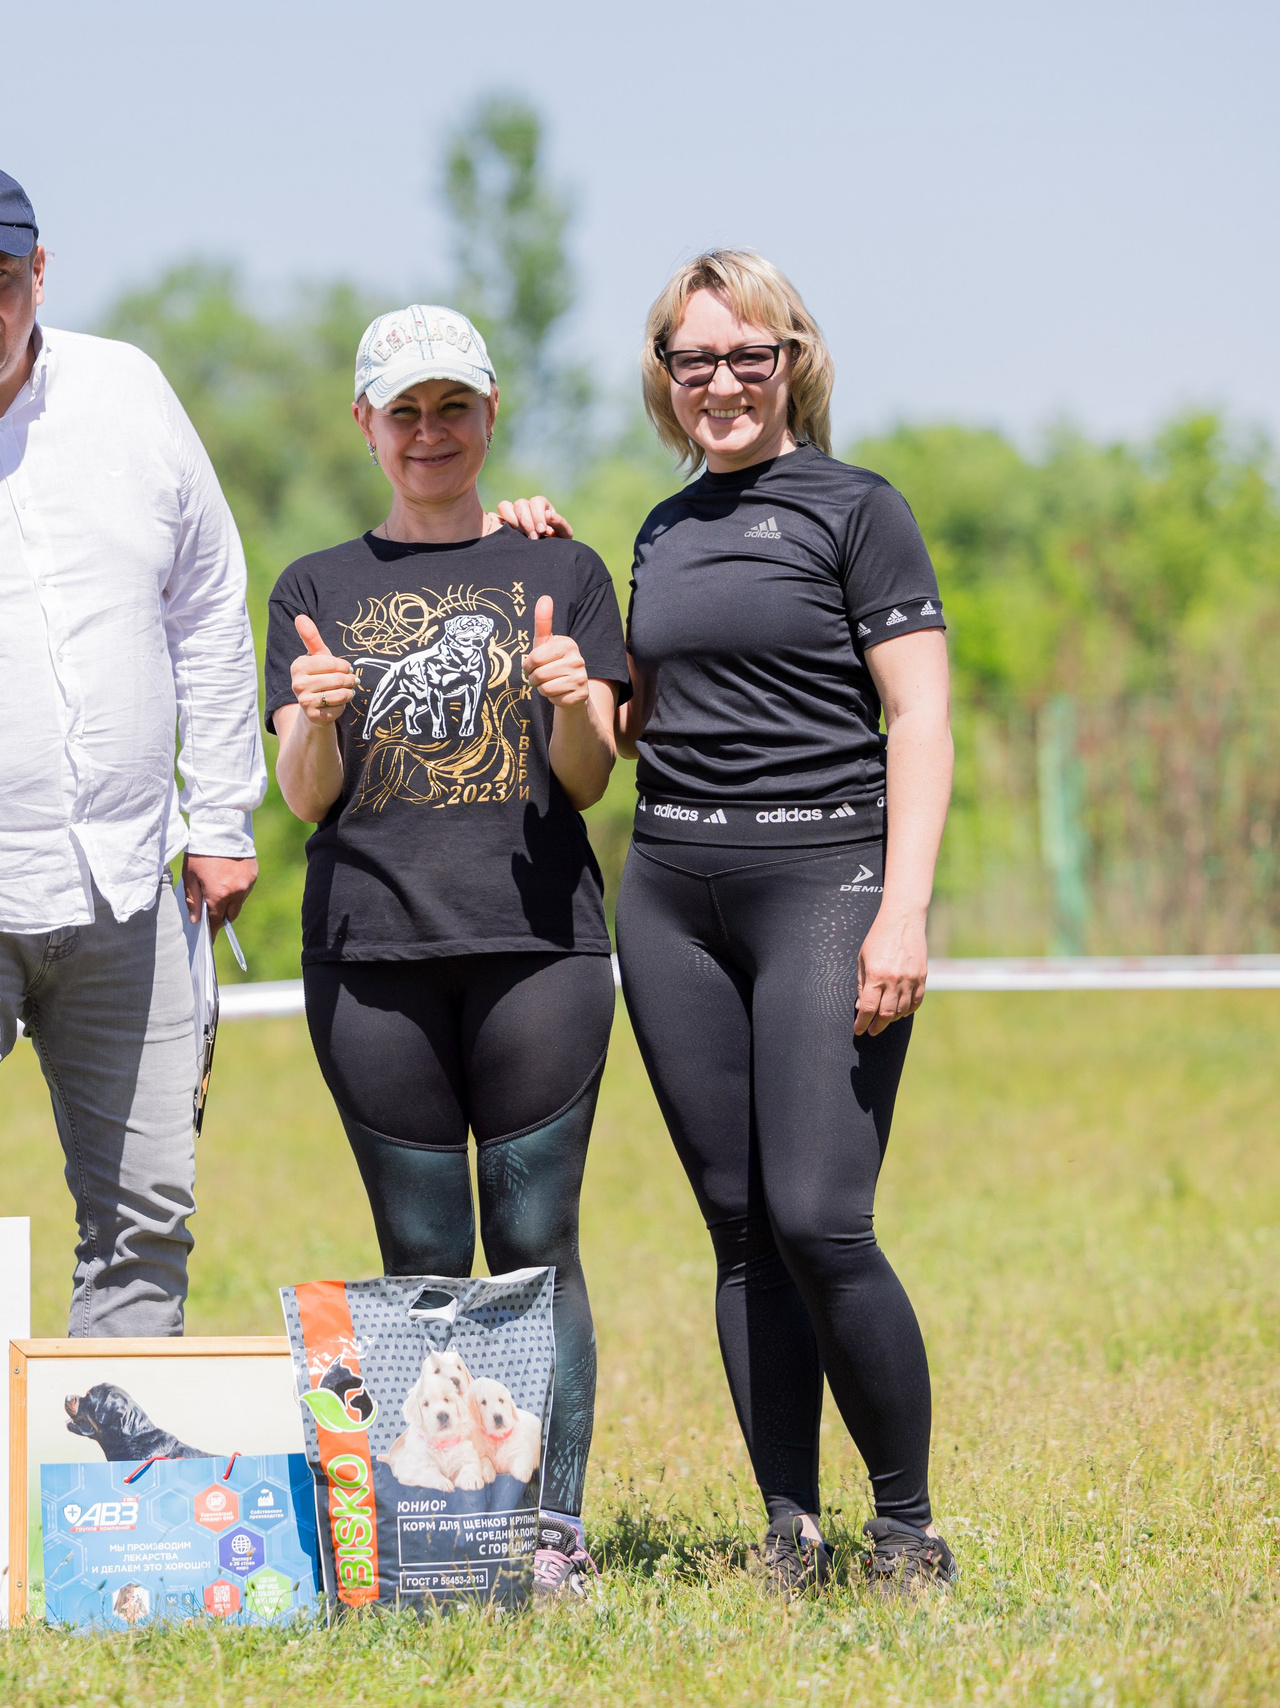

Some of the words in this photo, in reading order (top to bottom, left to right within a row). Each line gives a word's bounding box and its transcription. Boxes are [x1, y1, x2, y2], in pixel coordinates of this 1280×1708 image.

[373, 320, 471, 361] CHICAGO
[744, 530, 781, 539] adidas
[885, 616, 908, 626] adidas
[517, 629, 534, 700] КУК
[447, 782, 508, 804] 2023
[653, 804, 699, 821] adidas
[756, 808, 823, 823] adidas
[397, 1499, 447, 1513] ЮНИОР
[74, 1502, 139, 1526] АВЗ
[327, 1454, 376, 1589] BISKO
[403, 1521, 436, 1531] КОРМ
[438, 1521, 460, 1531] ДЛЯ
[463, 1517, 507, 1530] ЩЕНКОВ
[465, 1533, 473, 1542] И
[476, 1529, 519, 1541] СРЕДНИХ
[110, 1544, 125, 1552] МЫ
[127, 1541, 192, 1551] ПРОИЗВОДИМ
[478, 1544, 486, 1555] С
[123, 1553, 179, 1562] ЛЕКАРСТВА
[91, 1566, 99, 1574] И
[101, 1564, 141, 1574] ДЕЛАЕМ
[143, 1563, 162, 1571] ЭТО
[165, 1561, 211, 1571] ХОРОШО!
[406, 1577, 431, 1587] ГОСТ
